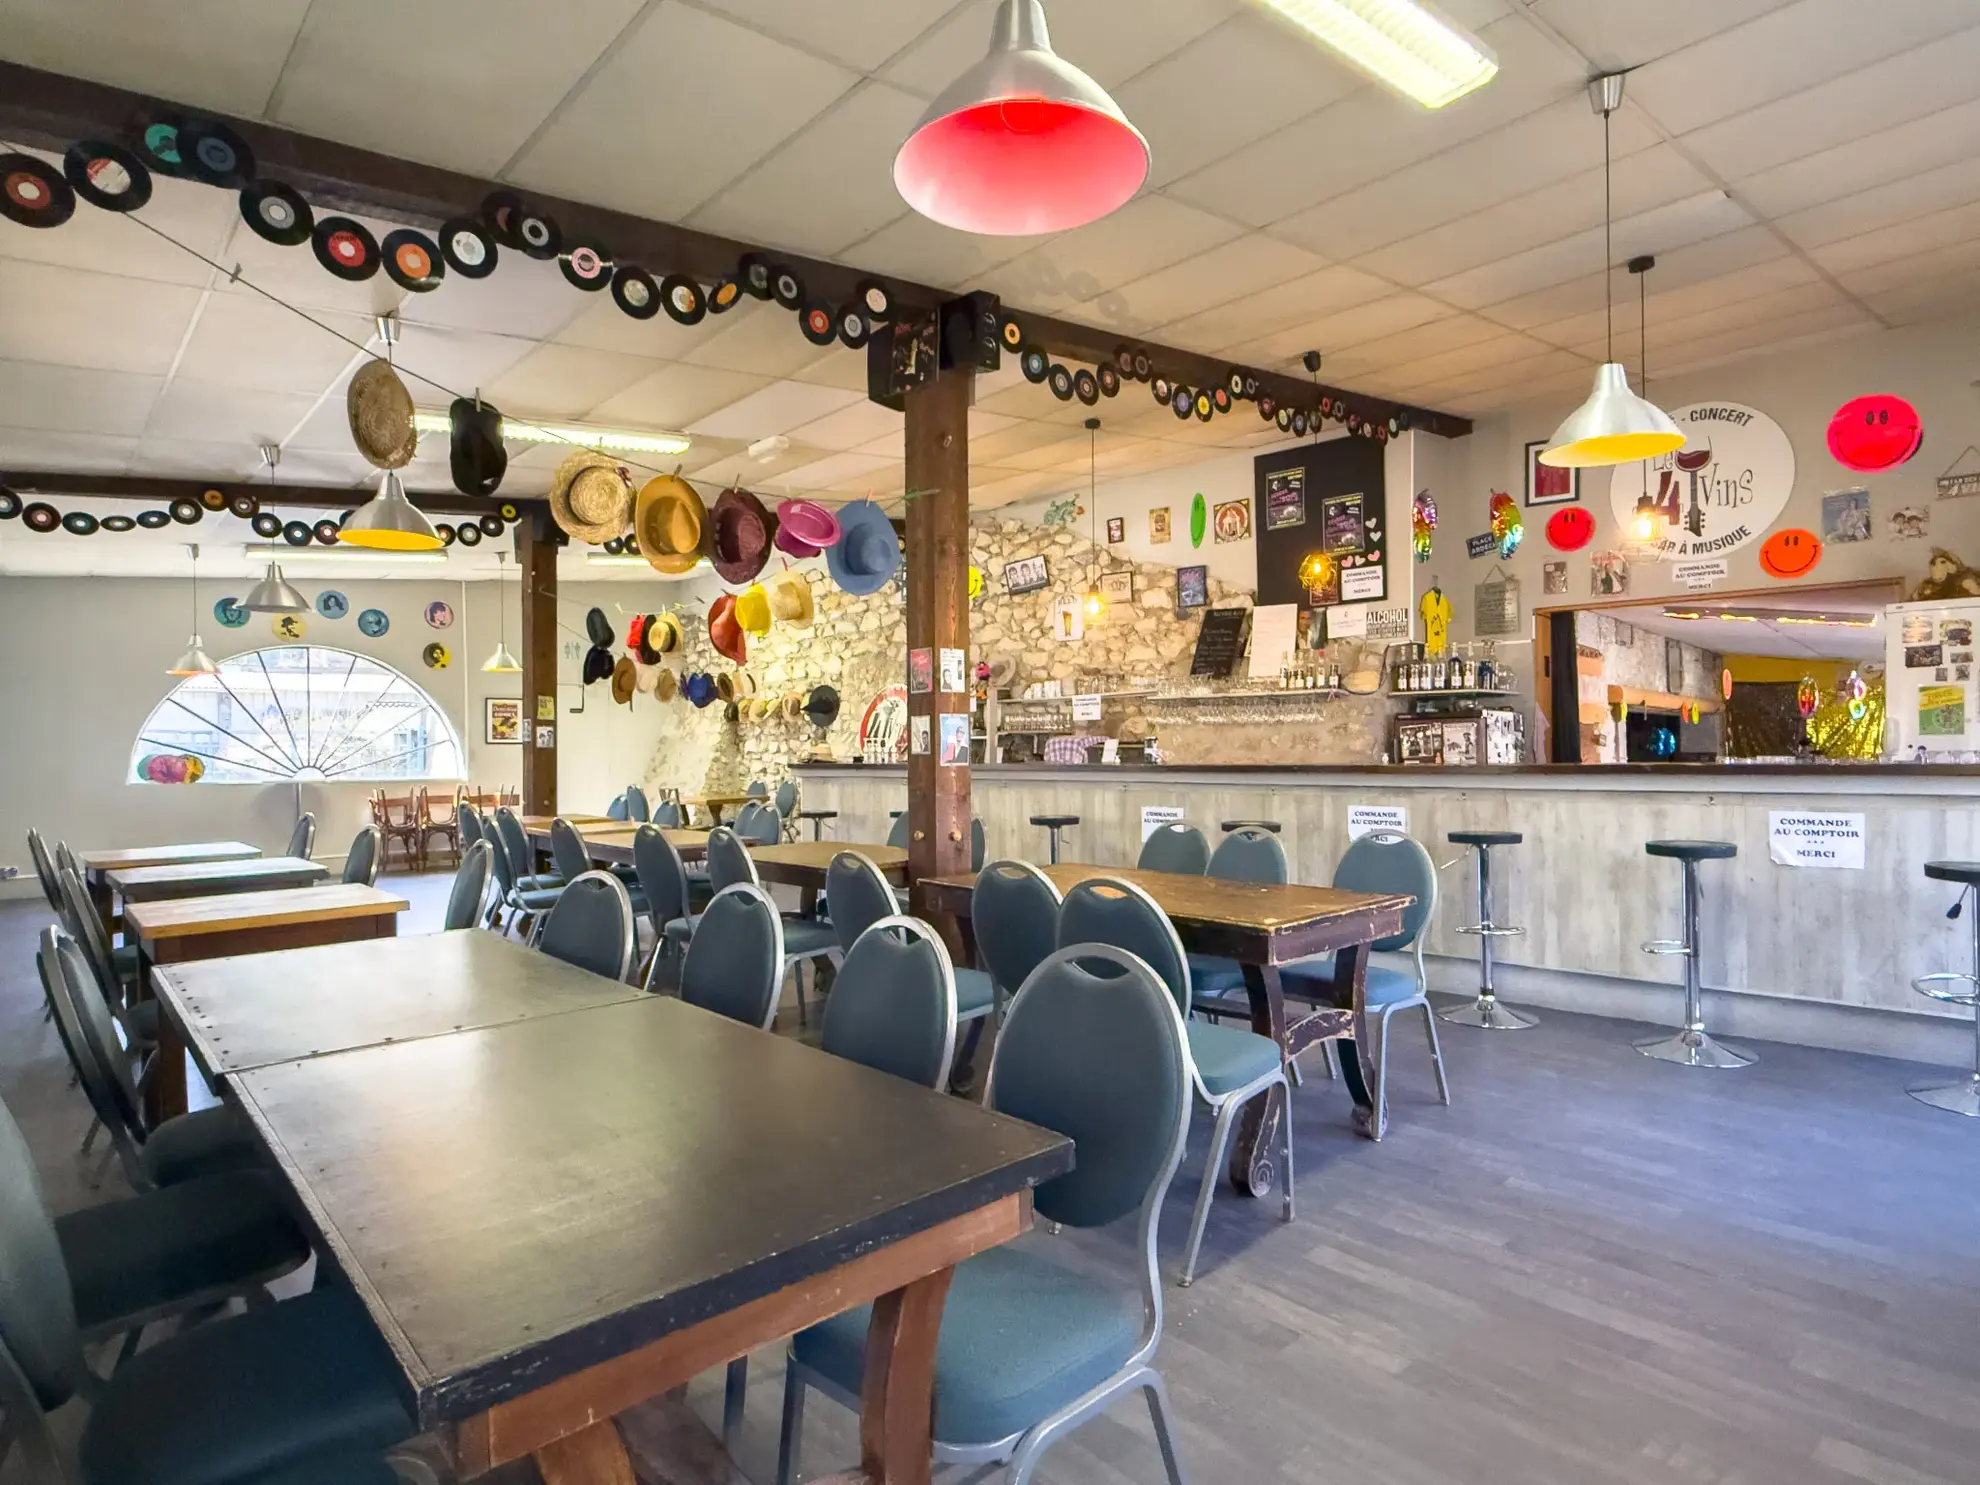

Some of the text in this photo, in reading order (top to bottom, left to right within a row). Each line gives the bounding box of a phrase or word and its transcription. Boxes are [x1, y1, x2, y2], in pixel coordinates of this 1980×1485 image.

[1690, 407, 1754, 427] CONCERT
[1699, 462, 1754, 508] Vins
[1692, 525, 1752, 556] MUSIQUE
[1687, 569, 1725, 578] COMPTOIR
[1366, 608, 1408, 625] ALCOHOL
[1780, 818, 1853, 827] COMMANDE
[1774, 828, 1860, 838] AU COMPTOIR
[1797, 849, 1836, 858] MERCI
